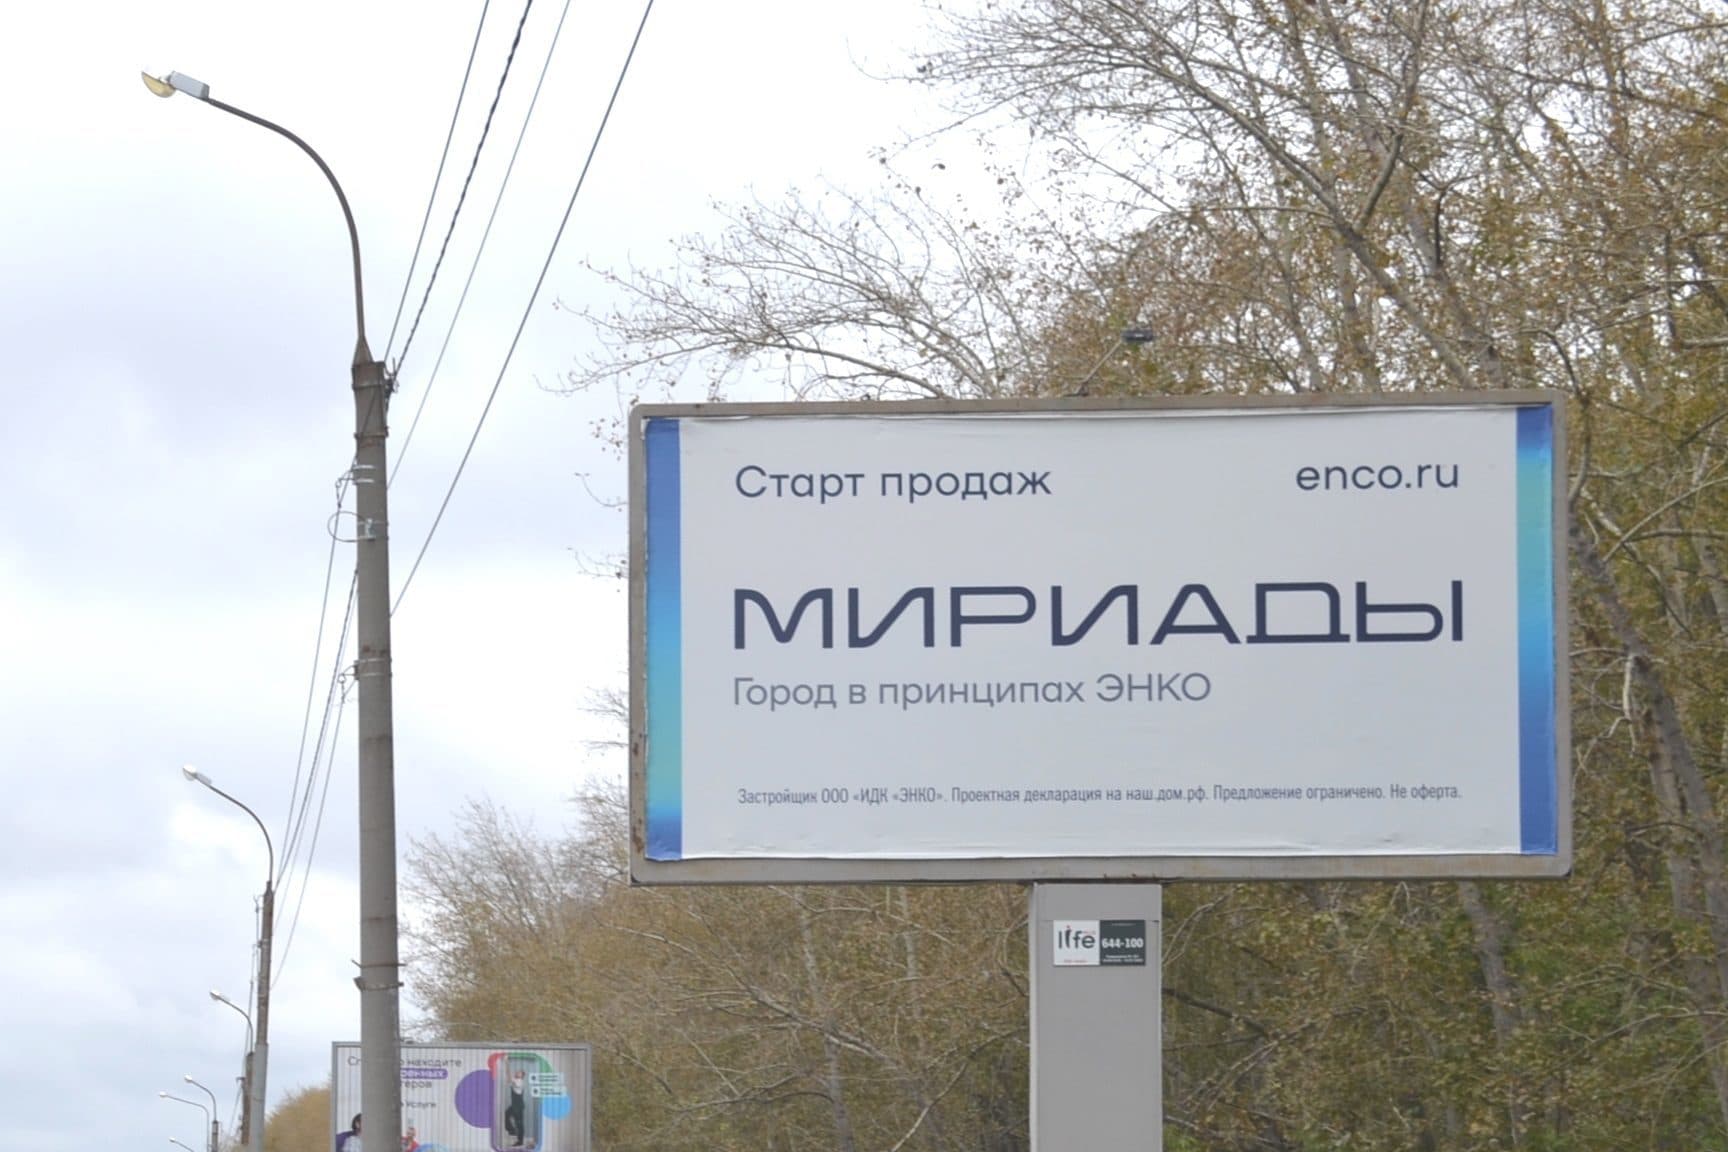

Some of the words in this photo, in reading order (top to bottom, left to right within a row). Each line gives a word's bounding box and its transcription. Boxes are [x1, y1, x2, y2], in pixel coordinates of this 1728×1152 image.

[734, 464, 866, 505] Старт
[879, 468, 1053, 505] продаж
[1295, 460, 1459, 492] enco.ru
[733, 579, 1464, 651] МИРИАДЫ
[733, 676, 838, 713] Город
[848, 683, 867, 705] в
[878, 680, 1086, 713] принципах
[1095, 672, 1212, 703] ЭНКО
[737, 788, 818, 806] Застройщик
[821, 787, 849, 804] ООО
[951, 786, 1020, 805] Проектная
[1023, 788, 1102, 805] декларация
[1105, 788, 1122, 802] на
[1213, 784, 1302, 803] Предложение
[1306, 785, 1386, 802] ограничено.
[1390, 783, 1407, 800] Не
[1410, 783, 1462, 801] оферта.
[1101, 937, 1145, 949] 644-100
